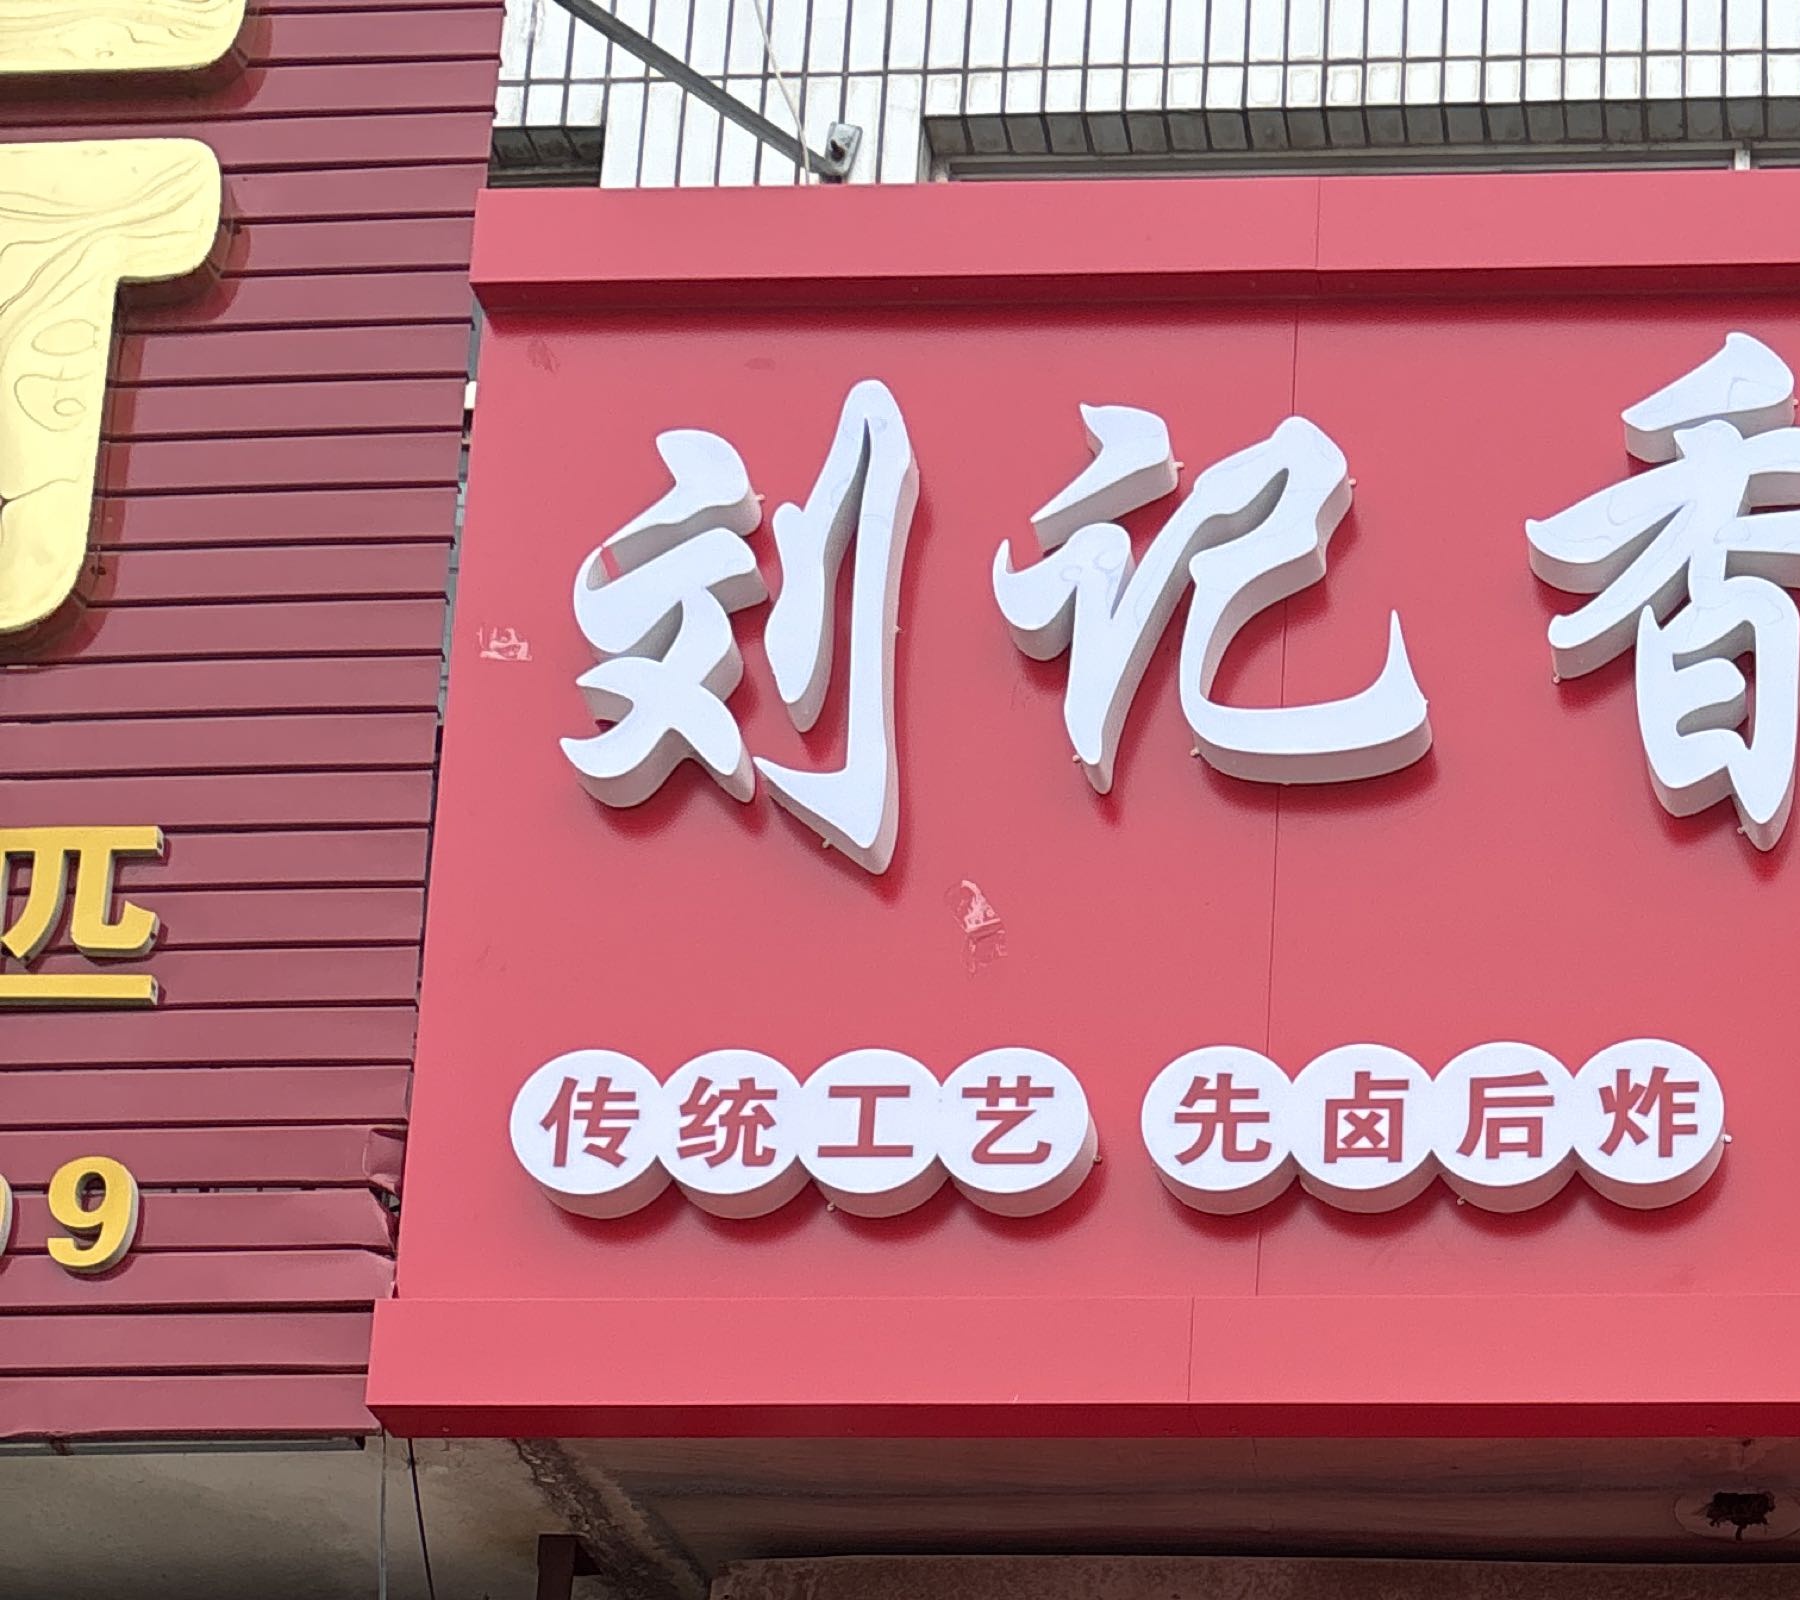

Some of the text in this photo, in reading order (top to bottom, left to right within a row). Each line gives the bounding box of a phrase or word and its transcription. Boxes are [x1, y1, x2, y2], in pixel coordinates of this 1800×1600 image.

[540, 1072, 1060, 1170] 传统工艺
[1171, 1065, 1702, 1169] 先卤后炸
[0, 1154, 137, 1274] 9
